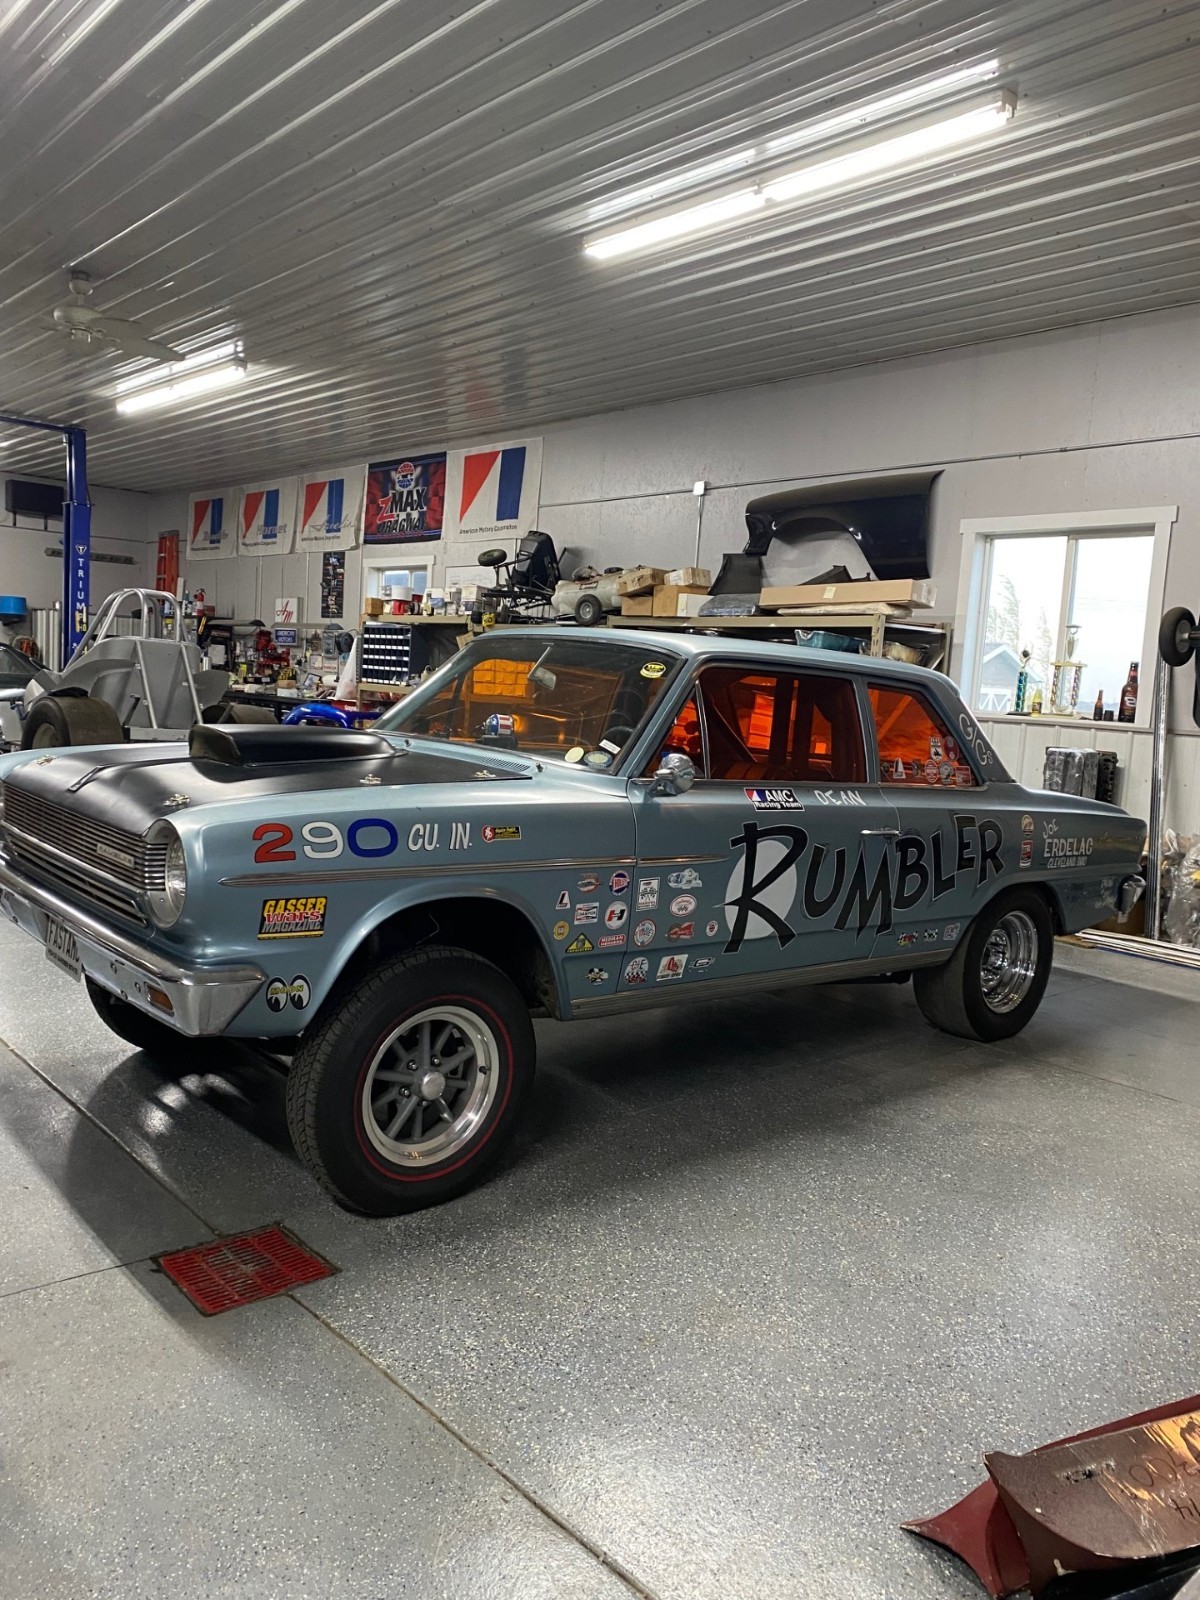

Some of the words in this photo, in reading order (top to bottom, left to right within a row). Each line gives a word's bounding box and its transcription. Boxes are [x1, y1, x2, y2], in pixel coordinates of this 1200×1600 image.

[764, 790, 794, 801] AMC
[754, 801, 781, 809] Racing
[252, 818, 398, 863] 290
[408, 823, 440, 851] CU.
[449, 822, 473, 850] IN.
[712, 814, 1006, 954] RUMBLER
[264, 897, 327, 917] GASSER
[271, 984, 304, 996] MOON
